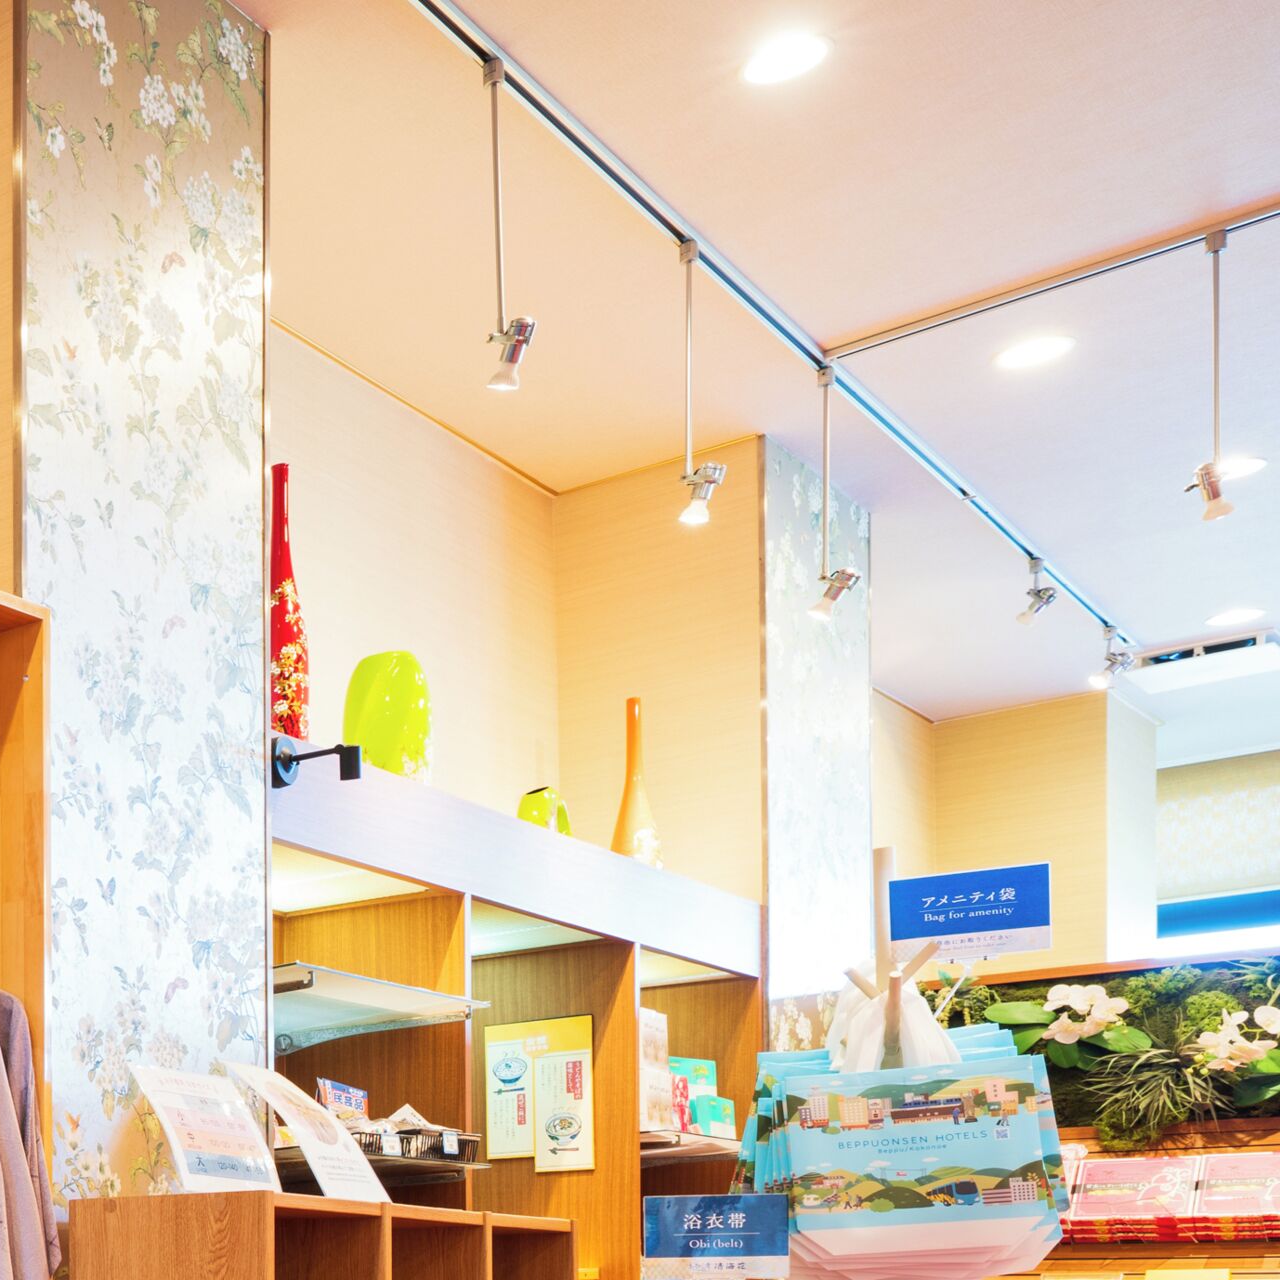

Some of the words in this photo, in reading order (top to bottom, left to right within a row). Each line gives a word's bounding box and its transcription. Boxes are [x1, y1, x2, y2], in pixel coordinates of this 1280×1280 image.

[921, 887, 1016, 908] アメニティ袋
[924, 913, 946, 922] Bag
[949, 910, 966, 919] for
[968, 906, 1014, 917] amenity
[837, 1135, 928, 1150] BEPPUONSEN
[935, 1130, 988, 1142] HOTELS
[683, 1212, 747, 1230] 浴衣帯
